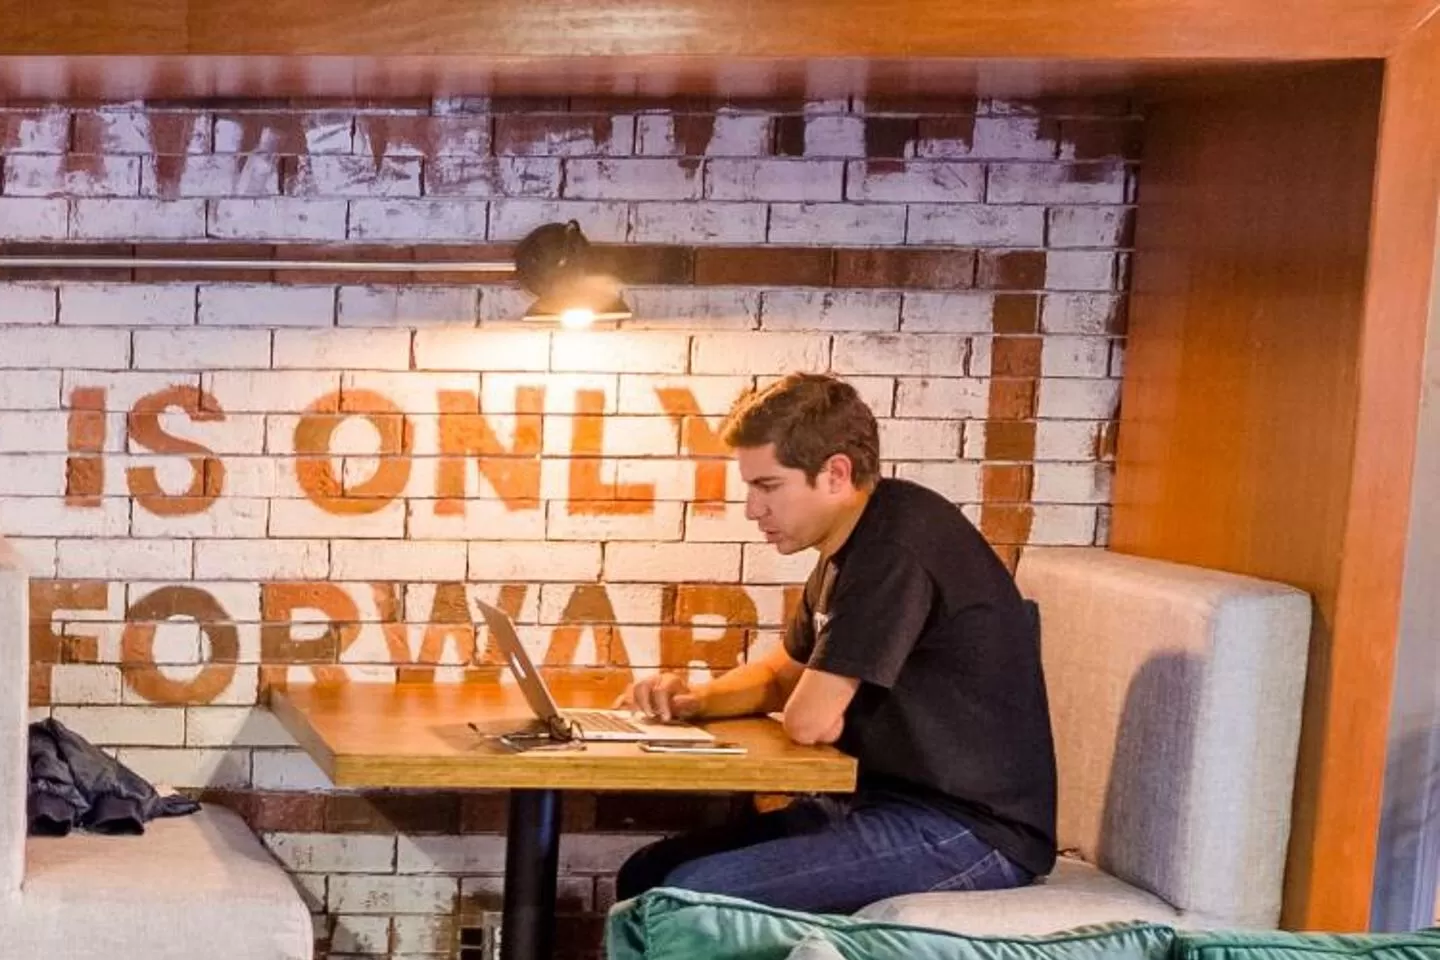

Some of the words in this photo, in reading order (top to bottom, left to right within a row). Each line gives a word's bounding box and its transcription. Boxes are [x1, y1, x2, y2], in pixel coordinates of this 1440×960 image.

[63, 384, 225, 516] IS
[294, 384, 738, 516] ONLY
[29, 582, 804, 706] FORWAR
